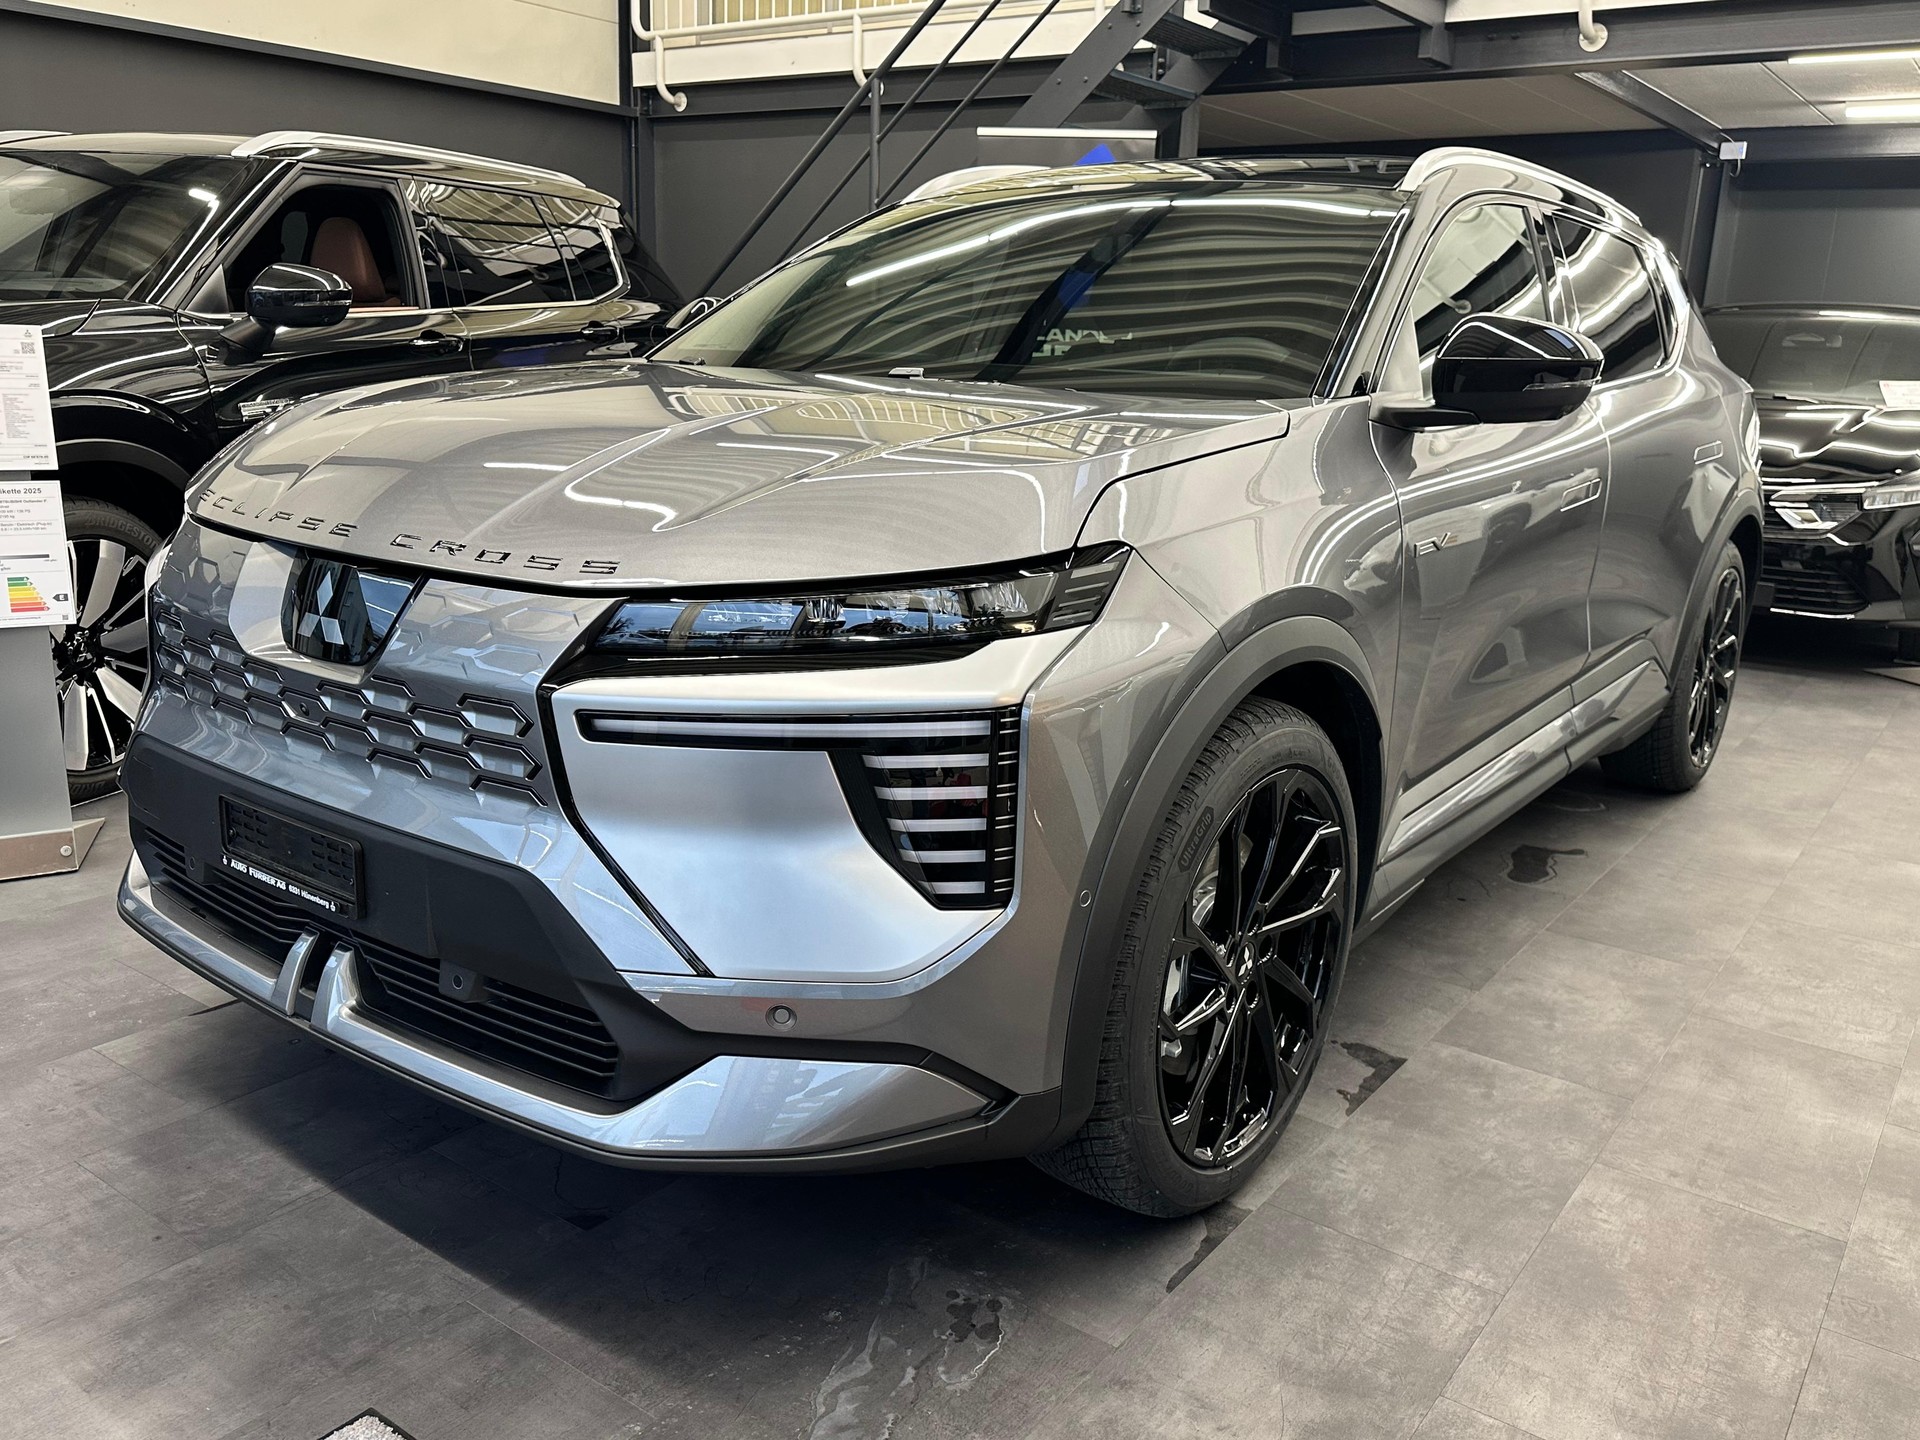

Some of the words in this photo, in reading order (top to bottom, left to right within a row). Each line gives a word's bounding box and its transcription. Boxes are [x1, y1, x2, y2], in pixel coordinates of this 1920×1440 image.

[200, 489, 360, 537] ECLIPSE
[390, 533, 621, 575] CROSS
[1181, 813, 1212, 867] UltraGrip
[230, 859, 247, 873] AUTO
[249, 866, 276, 887] FURRER
[276, 880, 287, 891] AG
